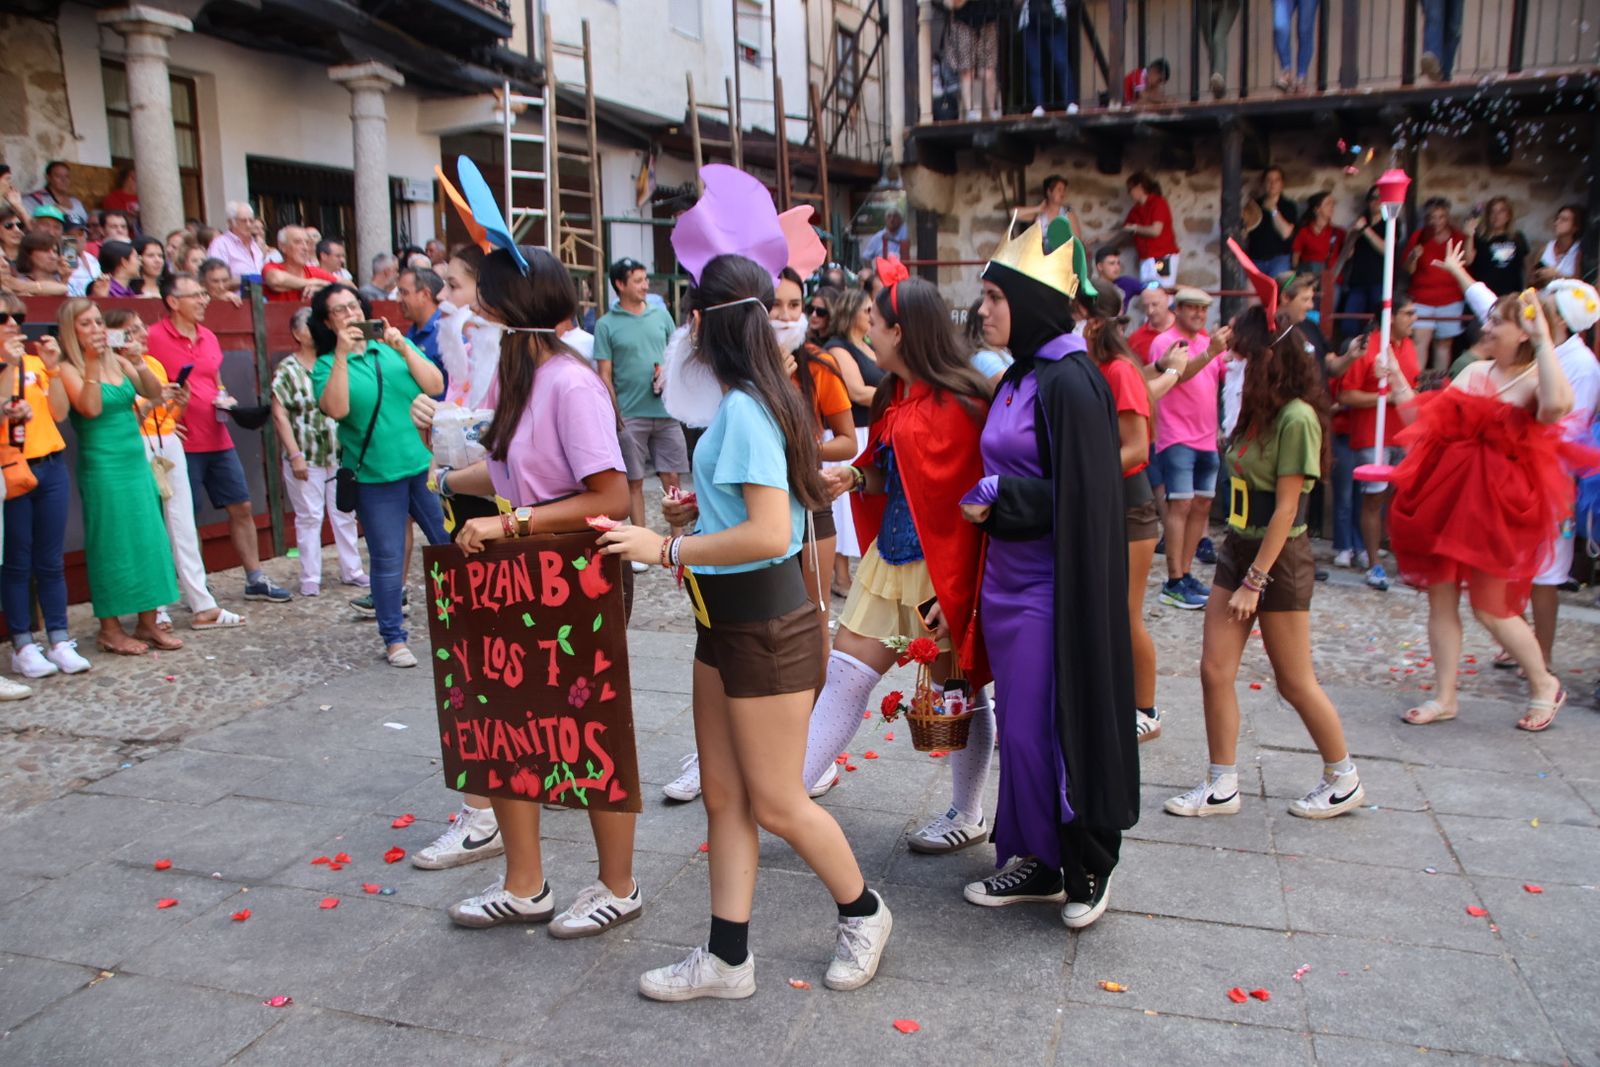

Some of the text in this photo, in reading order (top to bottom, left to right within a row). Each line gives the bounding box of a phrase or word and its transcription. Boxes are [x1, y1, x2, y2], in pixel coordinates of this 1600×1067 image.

[466, 552, 535, 613] PLAN
[538, 550, 570, 608] B
[453, 635, 561, 689] Y LOS 7
